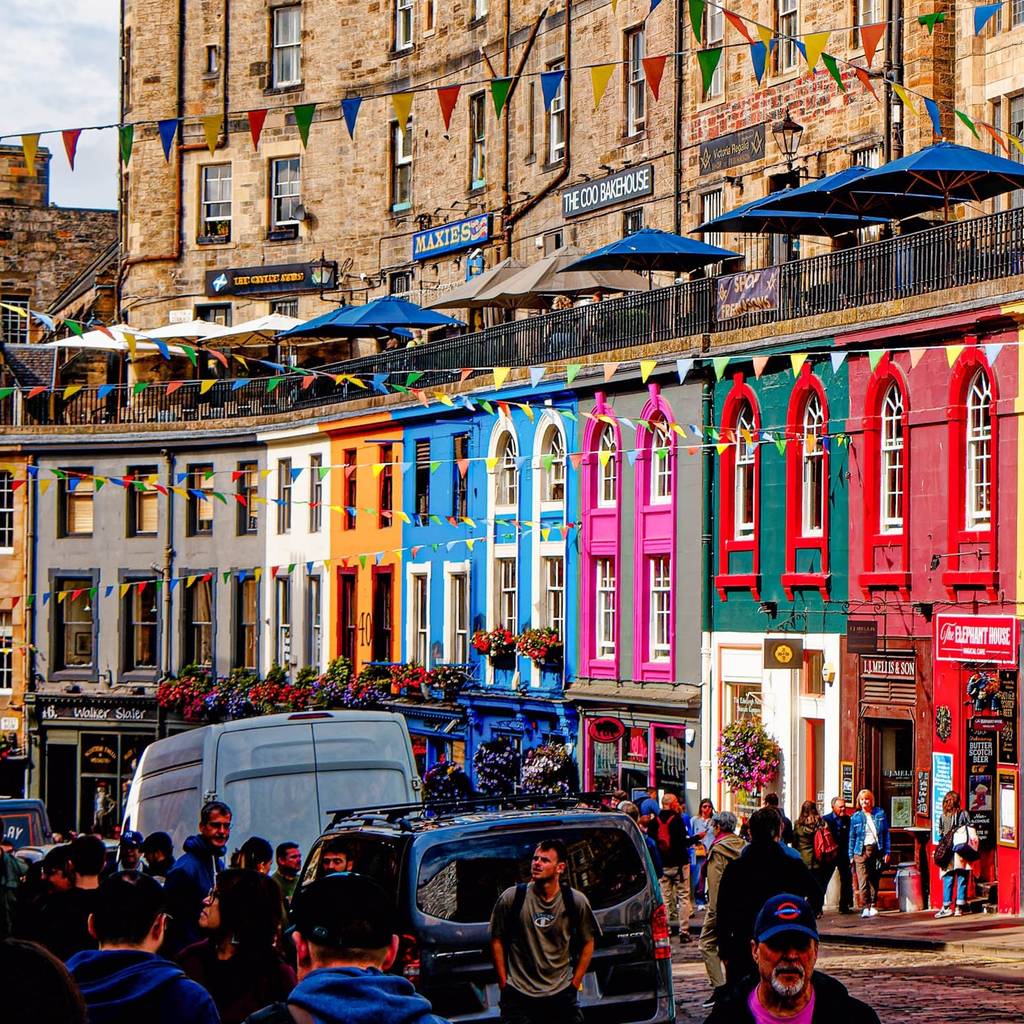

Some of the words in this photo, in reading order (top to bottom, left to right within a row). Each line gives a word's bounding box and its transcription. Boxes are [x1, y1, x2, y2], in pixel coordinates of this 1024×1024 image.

[564, 191, 579, 212] THE
[580, 184, 598, 207] COO
[600, 169, 649, 202] BAKEHOUSE
[734, 272, 761, 293] SHOP
[940, 622, 957, 645] The
[955, 625, 988, 644] ELEPHANT
[988, 626, 1011, 646] HOUSE
[900, 661, 915, 675] SON
[73, 706, 111, 719] Walker
